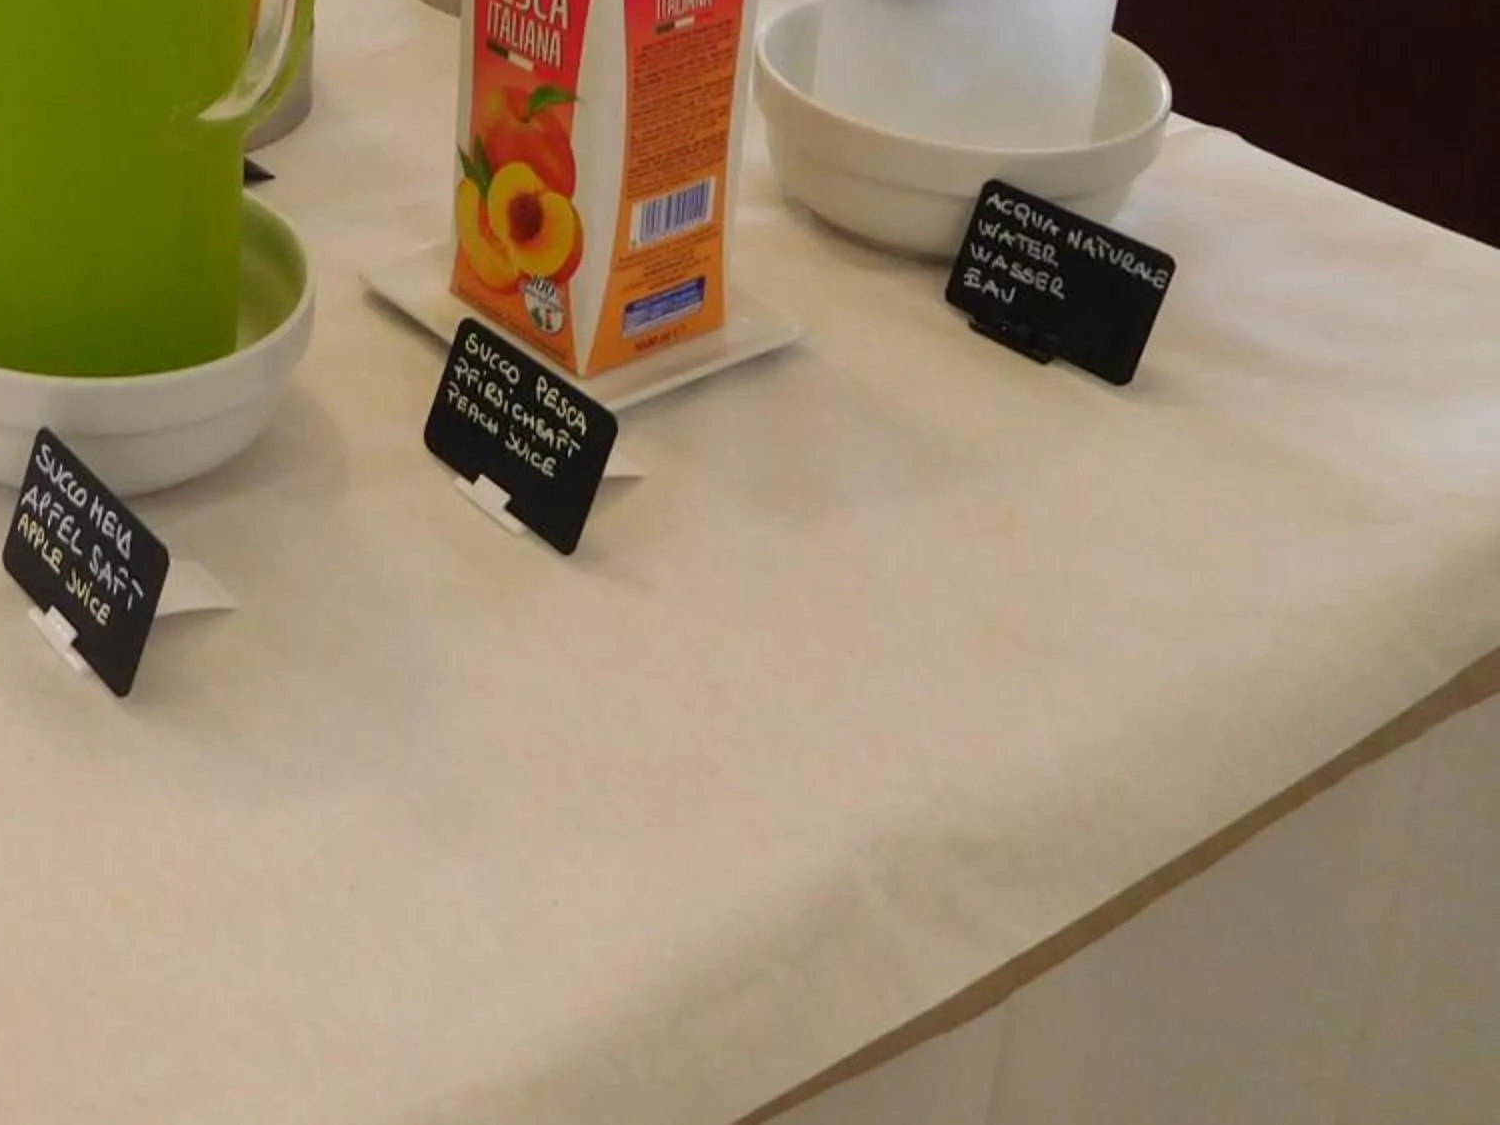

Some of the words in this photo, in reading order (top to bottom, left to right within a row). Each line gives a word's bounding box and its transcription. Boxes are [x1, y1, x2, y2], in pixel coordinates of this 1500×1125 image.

[486, 0, 562, 69] ITALIANA
[978, 218, 1059, 268] WATER
[985, 192, 1061, 237] ACQUA
[970, 241, 1066, 300] WASSER
[446, 380, 500, 436] PEACH
[464, 332, 521, 384] SUCCO
[534, 374, 588, 436] PESCA
[35, 443, 88, 508] SUCCO
[16, 512, 64, 575] APPLE
[20, 484, 84, 556] APFEL
[88, 544, 145, 611] SAFT
